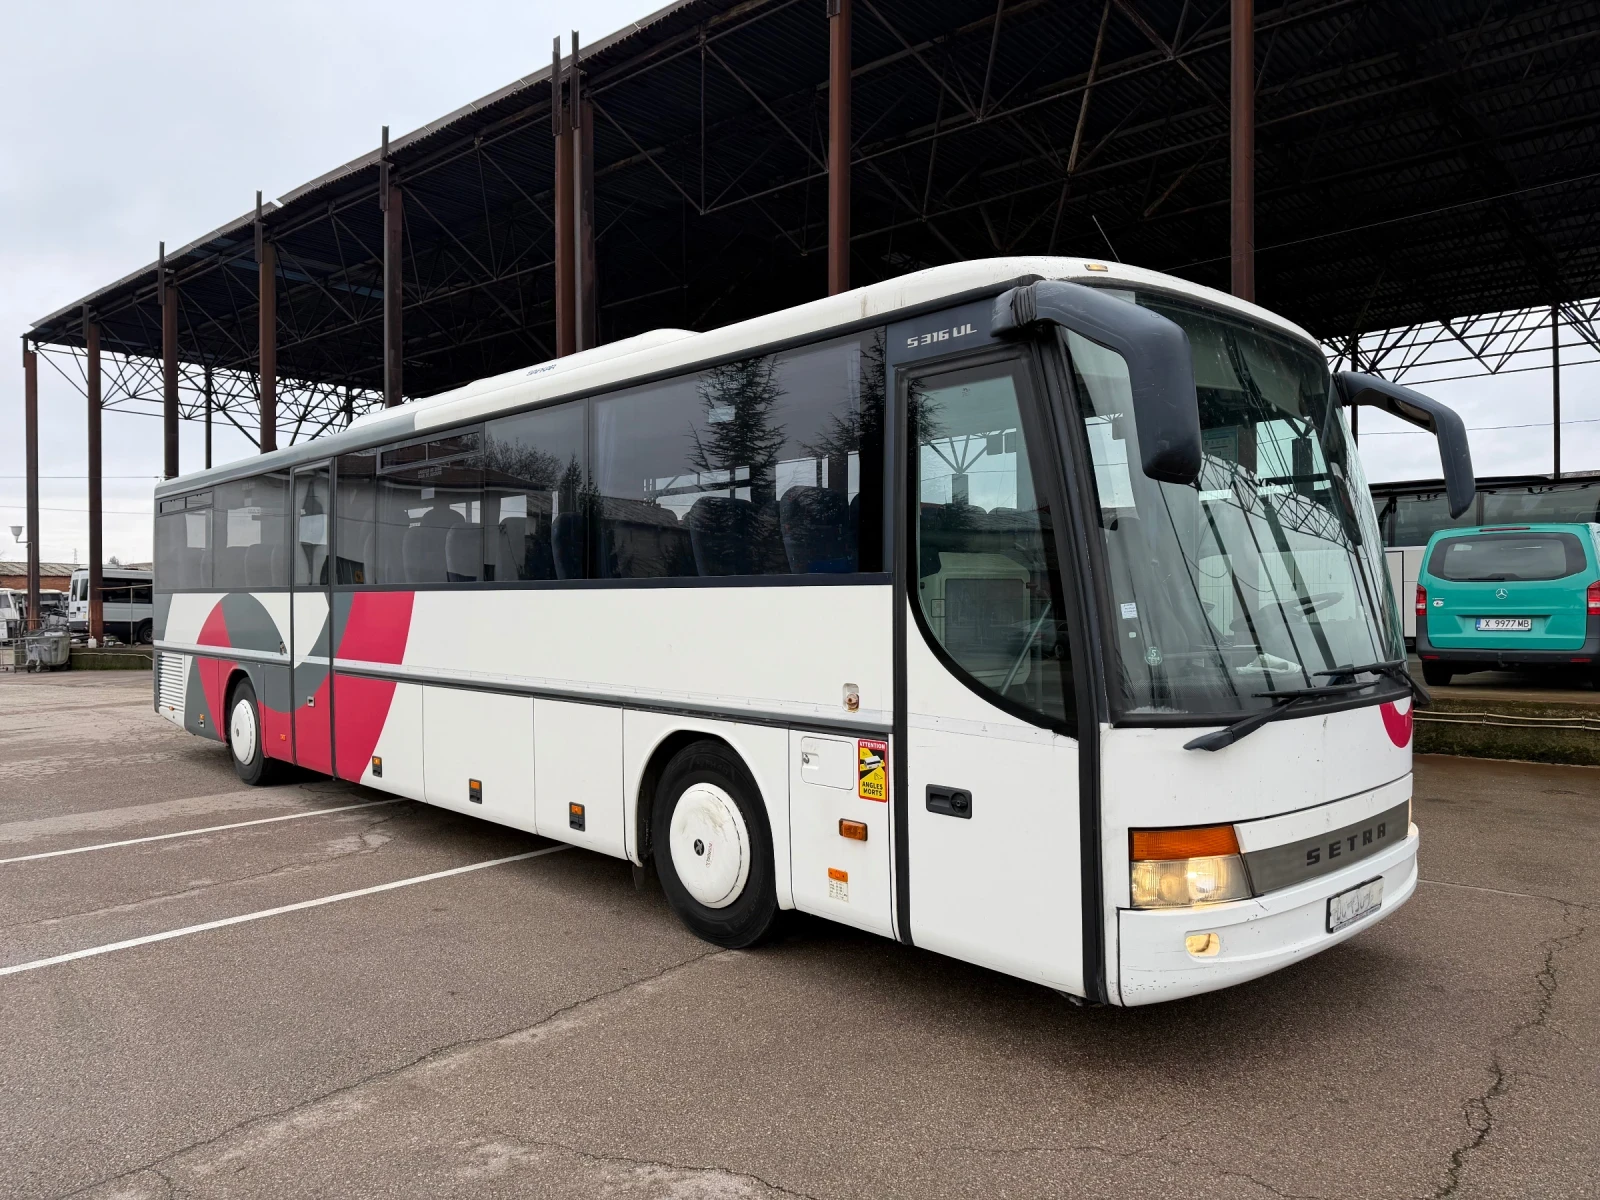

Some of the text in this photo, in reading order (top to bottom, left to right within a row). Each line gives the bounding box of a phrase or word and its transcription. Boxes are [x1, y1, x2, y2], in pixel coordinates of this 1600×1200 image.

[1484, 619, 1530, 628] X 9977 MB
[860, 741, 885, 749] ATTENTION
[862, 781, 883, 790] ANGLES
[863, 788, 883, 797] MORTS
[1306, 822, 1387, 866] SETRA
